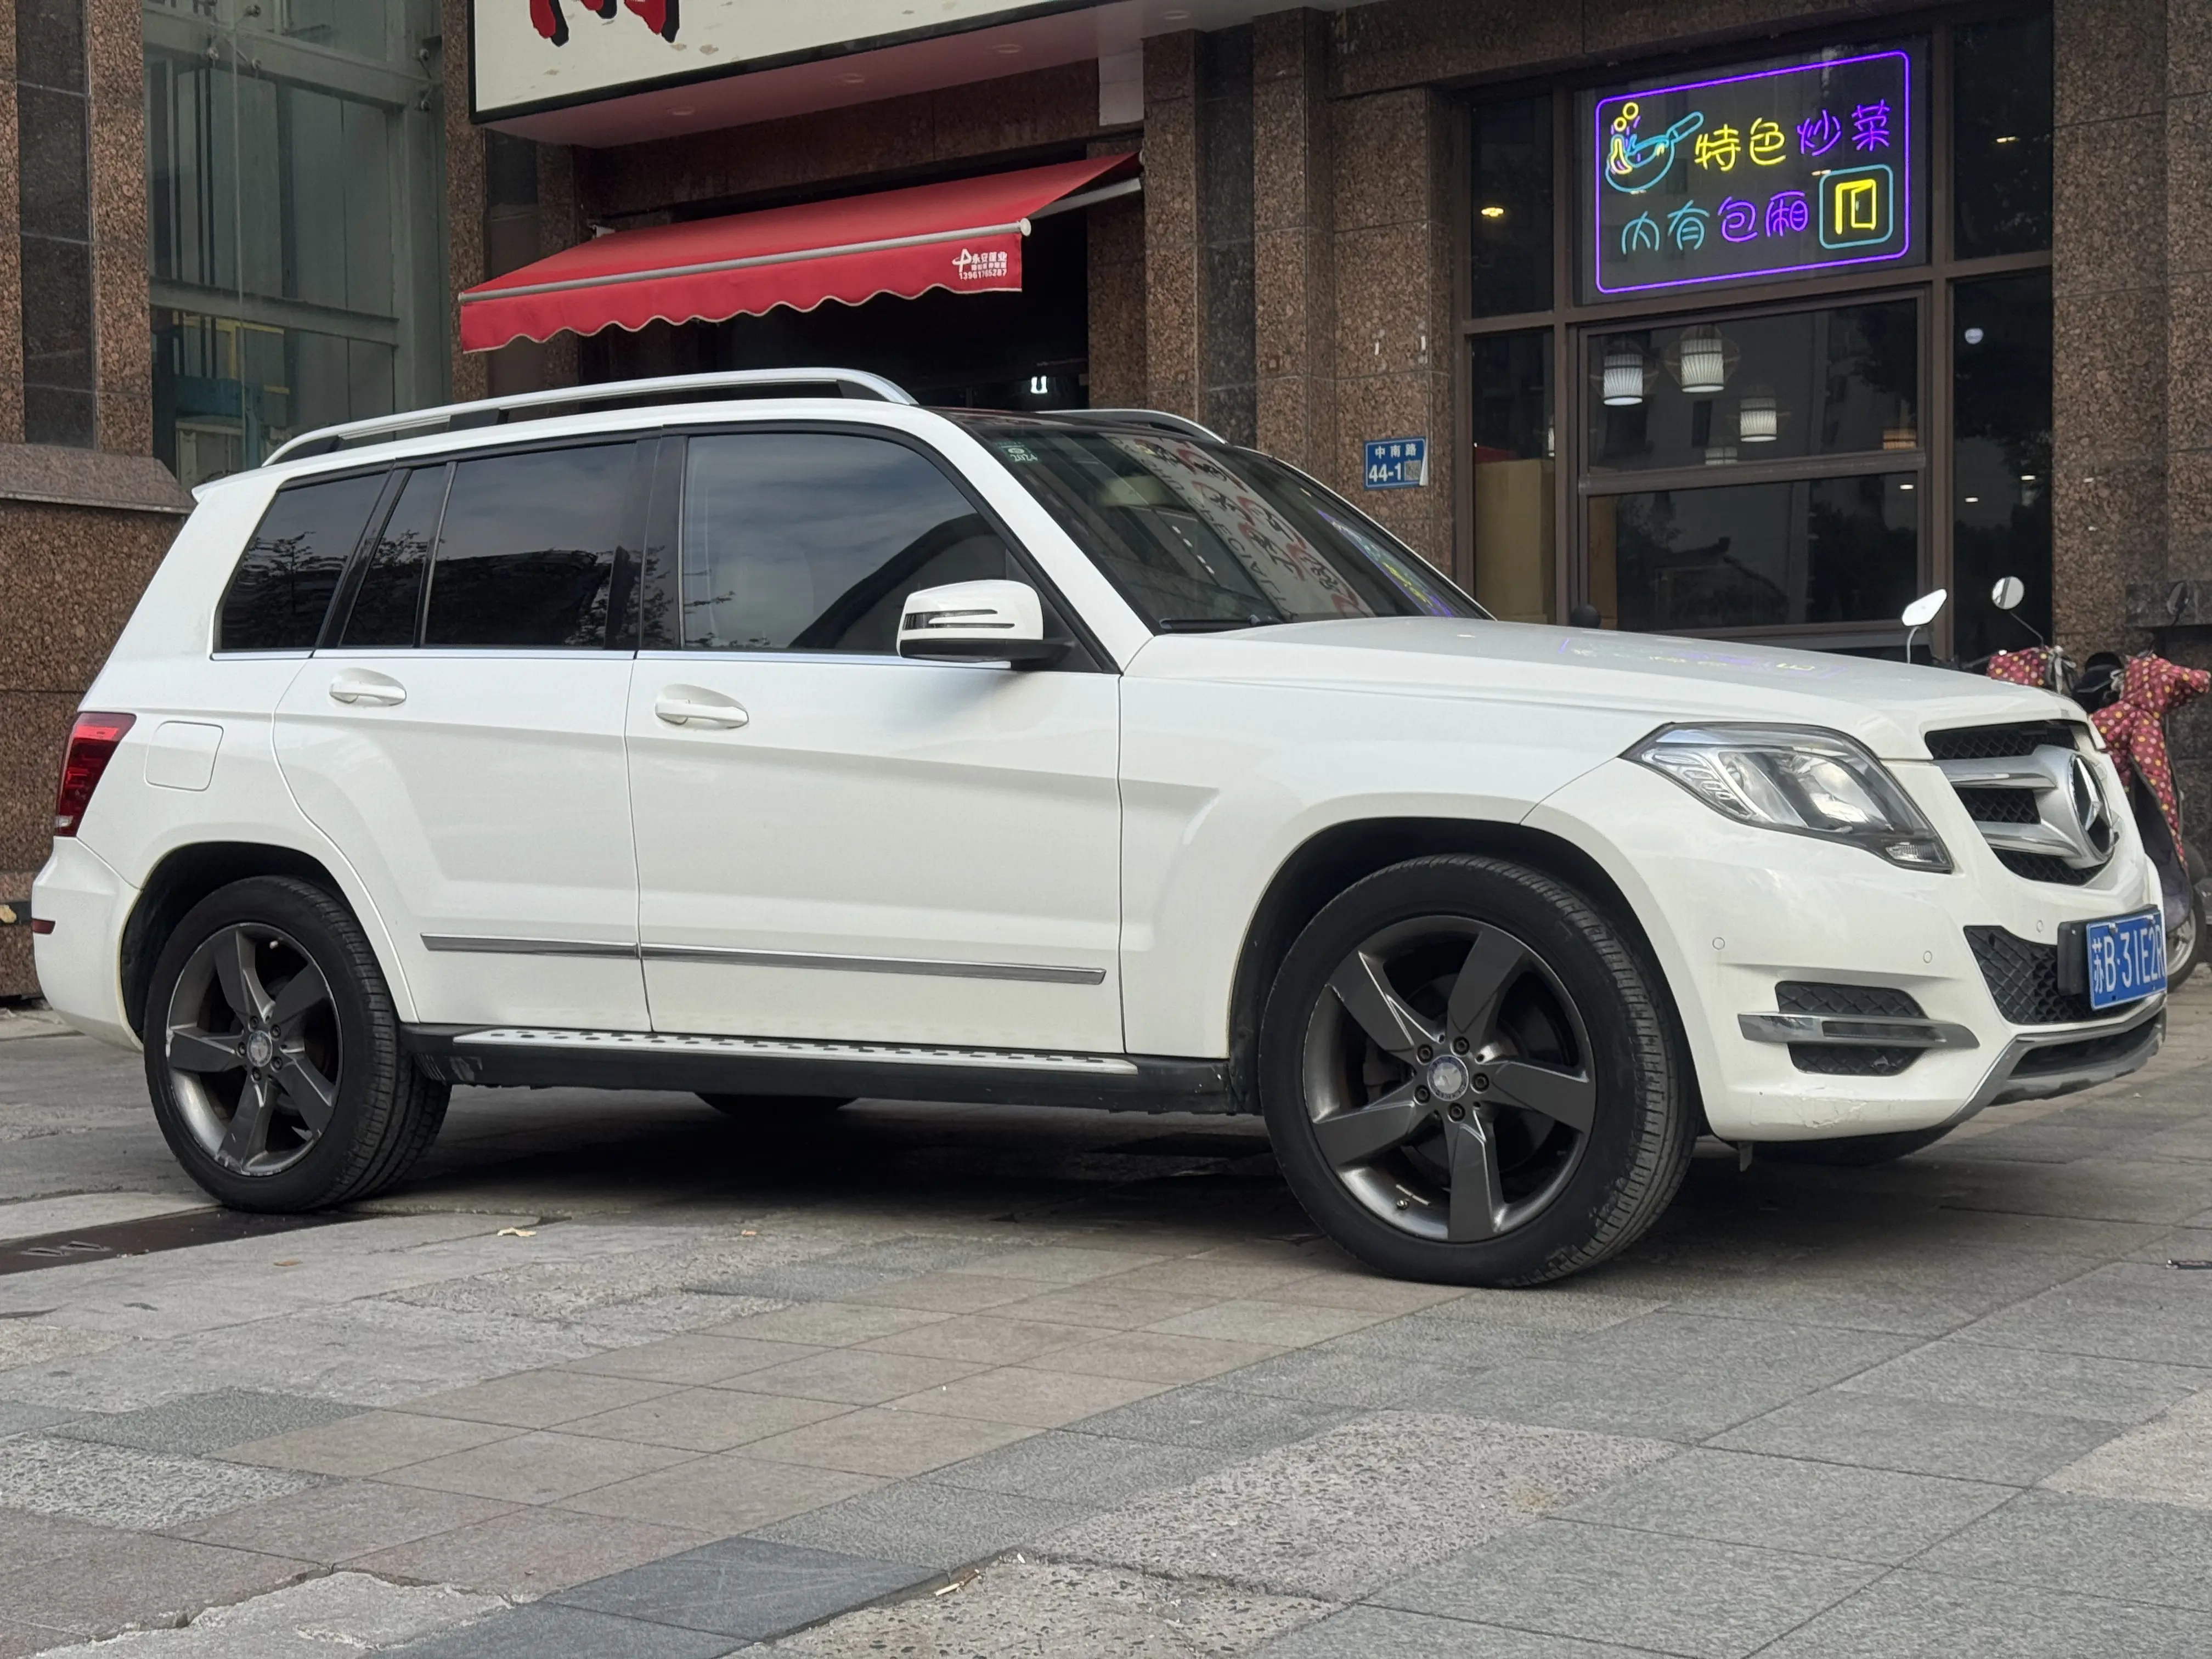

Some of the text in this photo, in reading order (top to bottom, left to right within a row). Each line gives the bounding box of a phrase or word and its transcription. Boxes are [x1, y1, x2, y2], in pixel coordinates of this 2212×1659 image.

[1694, 99, 1891, 172] 特色炒菜
[1621, 189, 1809, 255] 内有包厢
[1369, 462, 1401, 482] 44-1
[1374, 443, 1417, 459] 中南路
